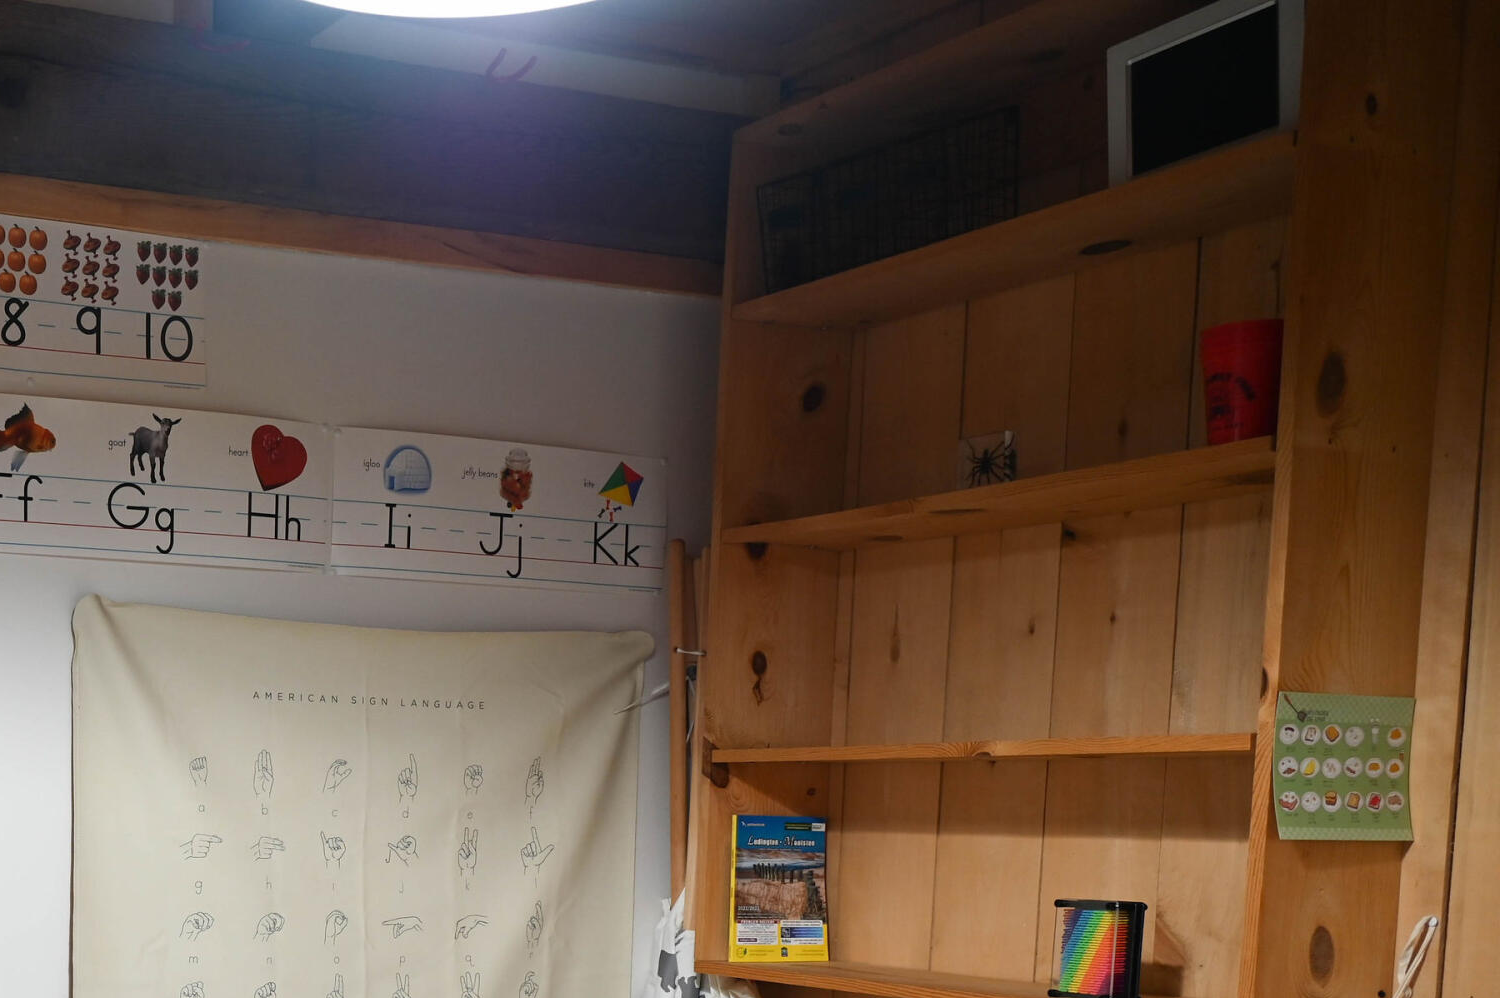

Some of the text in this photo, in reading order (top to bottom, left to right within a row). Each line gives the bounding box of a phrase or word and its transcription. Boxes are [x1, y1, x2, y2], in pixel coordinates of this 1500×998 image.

[1, 298, 29, 346] 8
[77, 306, 101, 355] 9
[146, 313, 192, 362] 10
[108, 439, 127, 451] goat
[229, 446, 248, 456] heart
[364, 458, 380, 471] igloo
[462, 467, 497, 479] jelly beans
[108, 481, 174, 554] Gg
[248, 490, 300, 541] Hh
[385, 503, 639, 578] Ii Jj Kk
[253, 692, 484, 709] AMERICAN SIGN LANGUAGE
[261, 804, 268, 815] b
[332, 809, 337, 817] c
[402, 808, 409, 819] d
[467, 811, 473, 819] e
[195, 881, 202, 894] g
[266, 879, 271, 889] h
[189, 956, 199, 964] m
[266, 956, 272, 964] n
[333, 956, 340, 964] o
[400, 956, 406, 966] p
[465, 956, 474, 968] q
